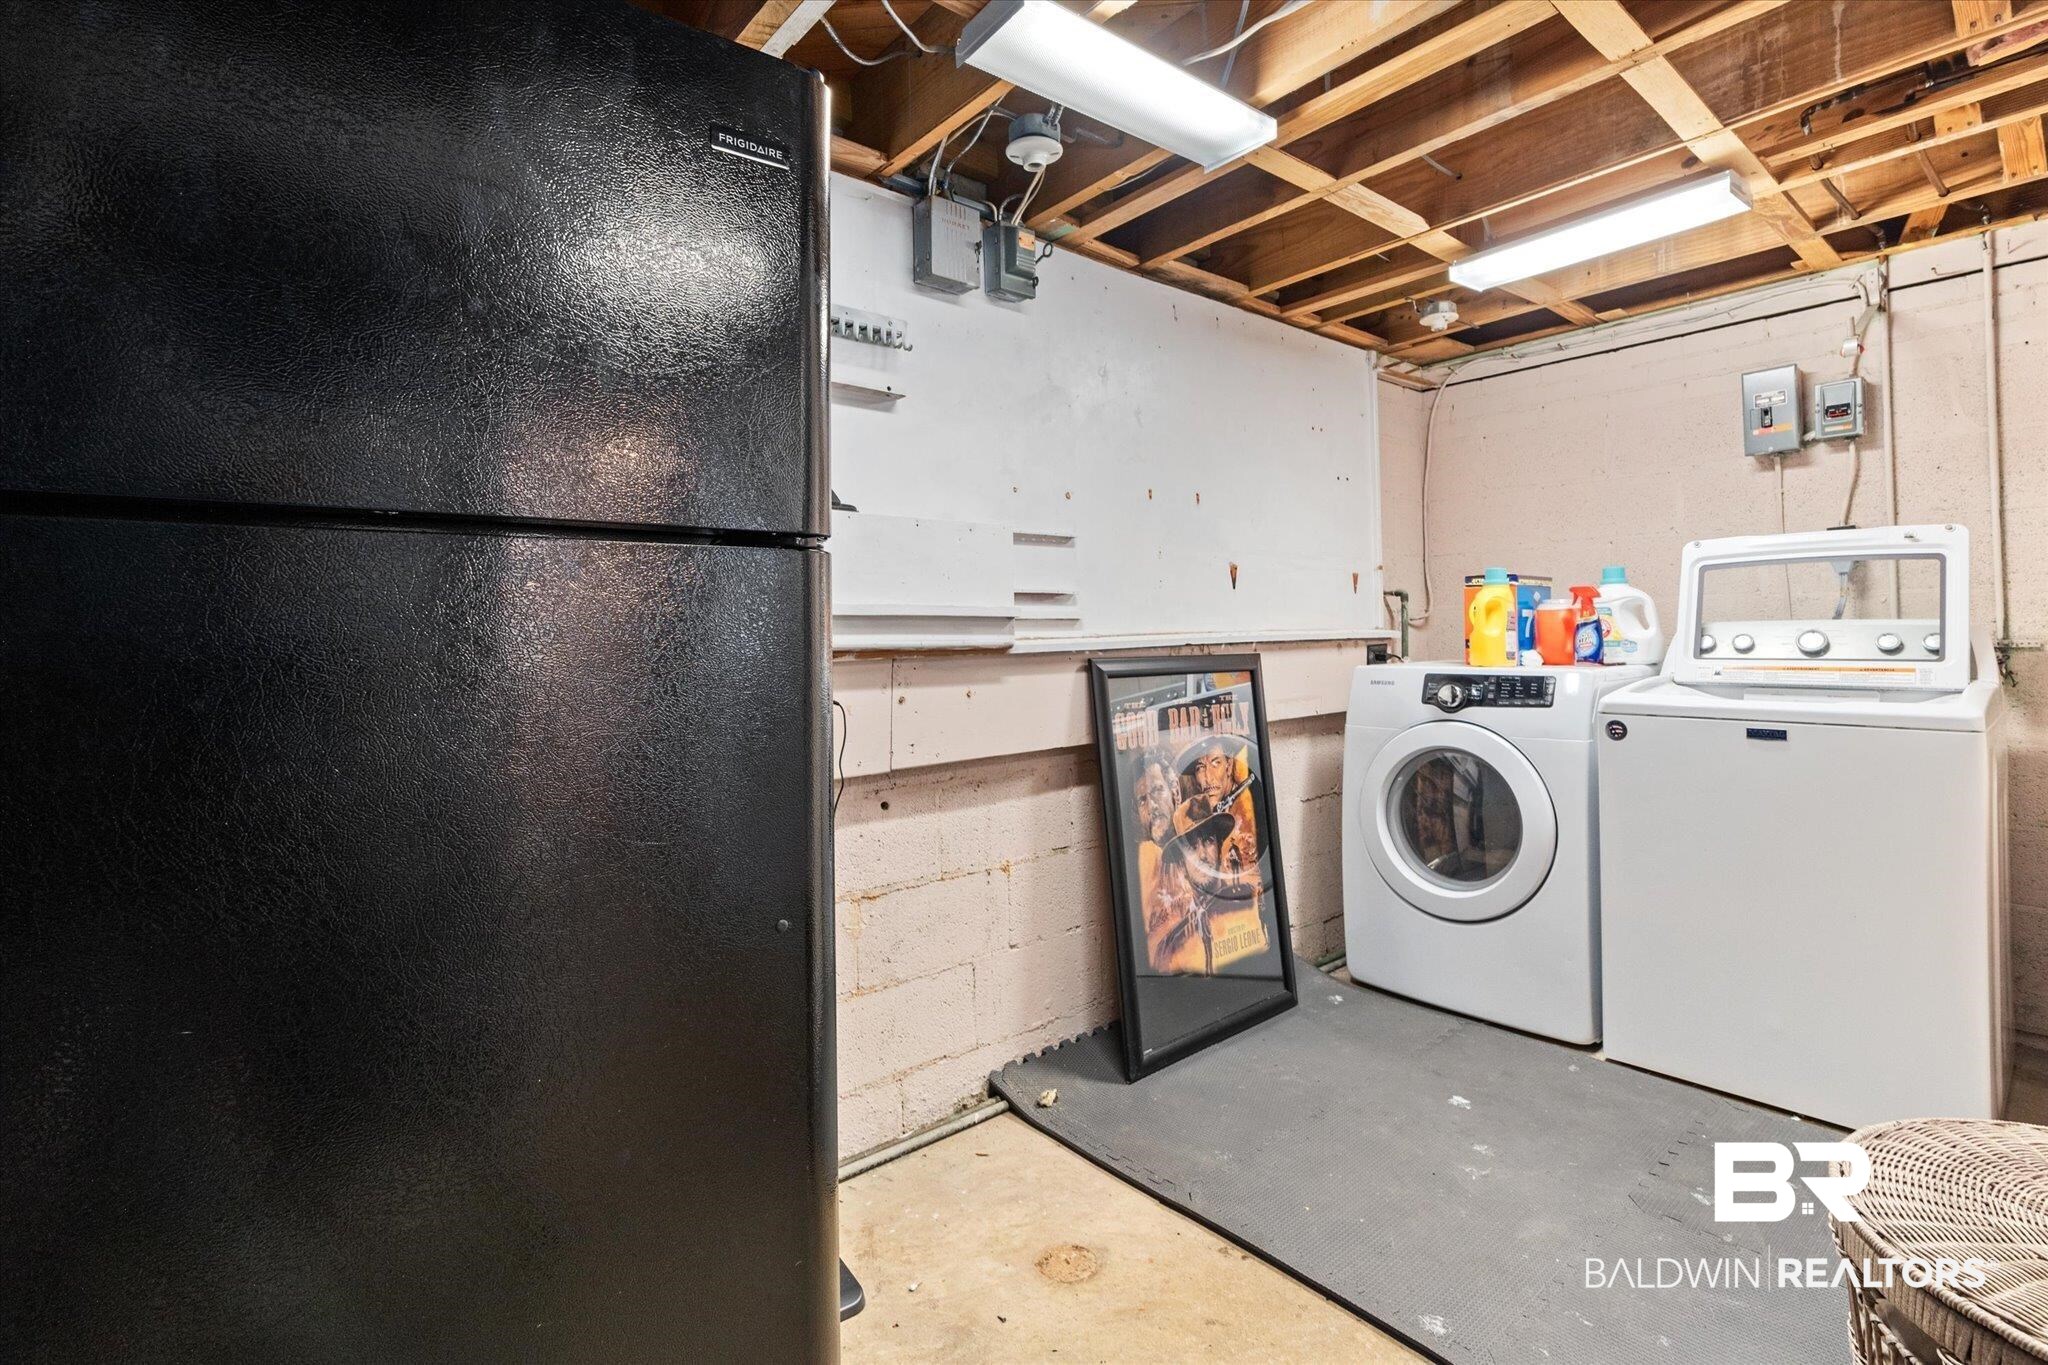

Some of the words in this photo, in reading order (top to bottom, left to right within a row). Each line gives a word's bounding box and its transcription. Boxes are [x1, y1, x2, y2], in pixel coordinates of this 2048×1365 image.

[718, 132, 783, 160] FRIGIDAIRE
[1521, 609, 1534, 638] 7
[1168, 705, 1200, 744] BAD
[1213, 935, 1238, 959] SERGIO
[1238, 928, 1261, 950] LEONE
